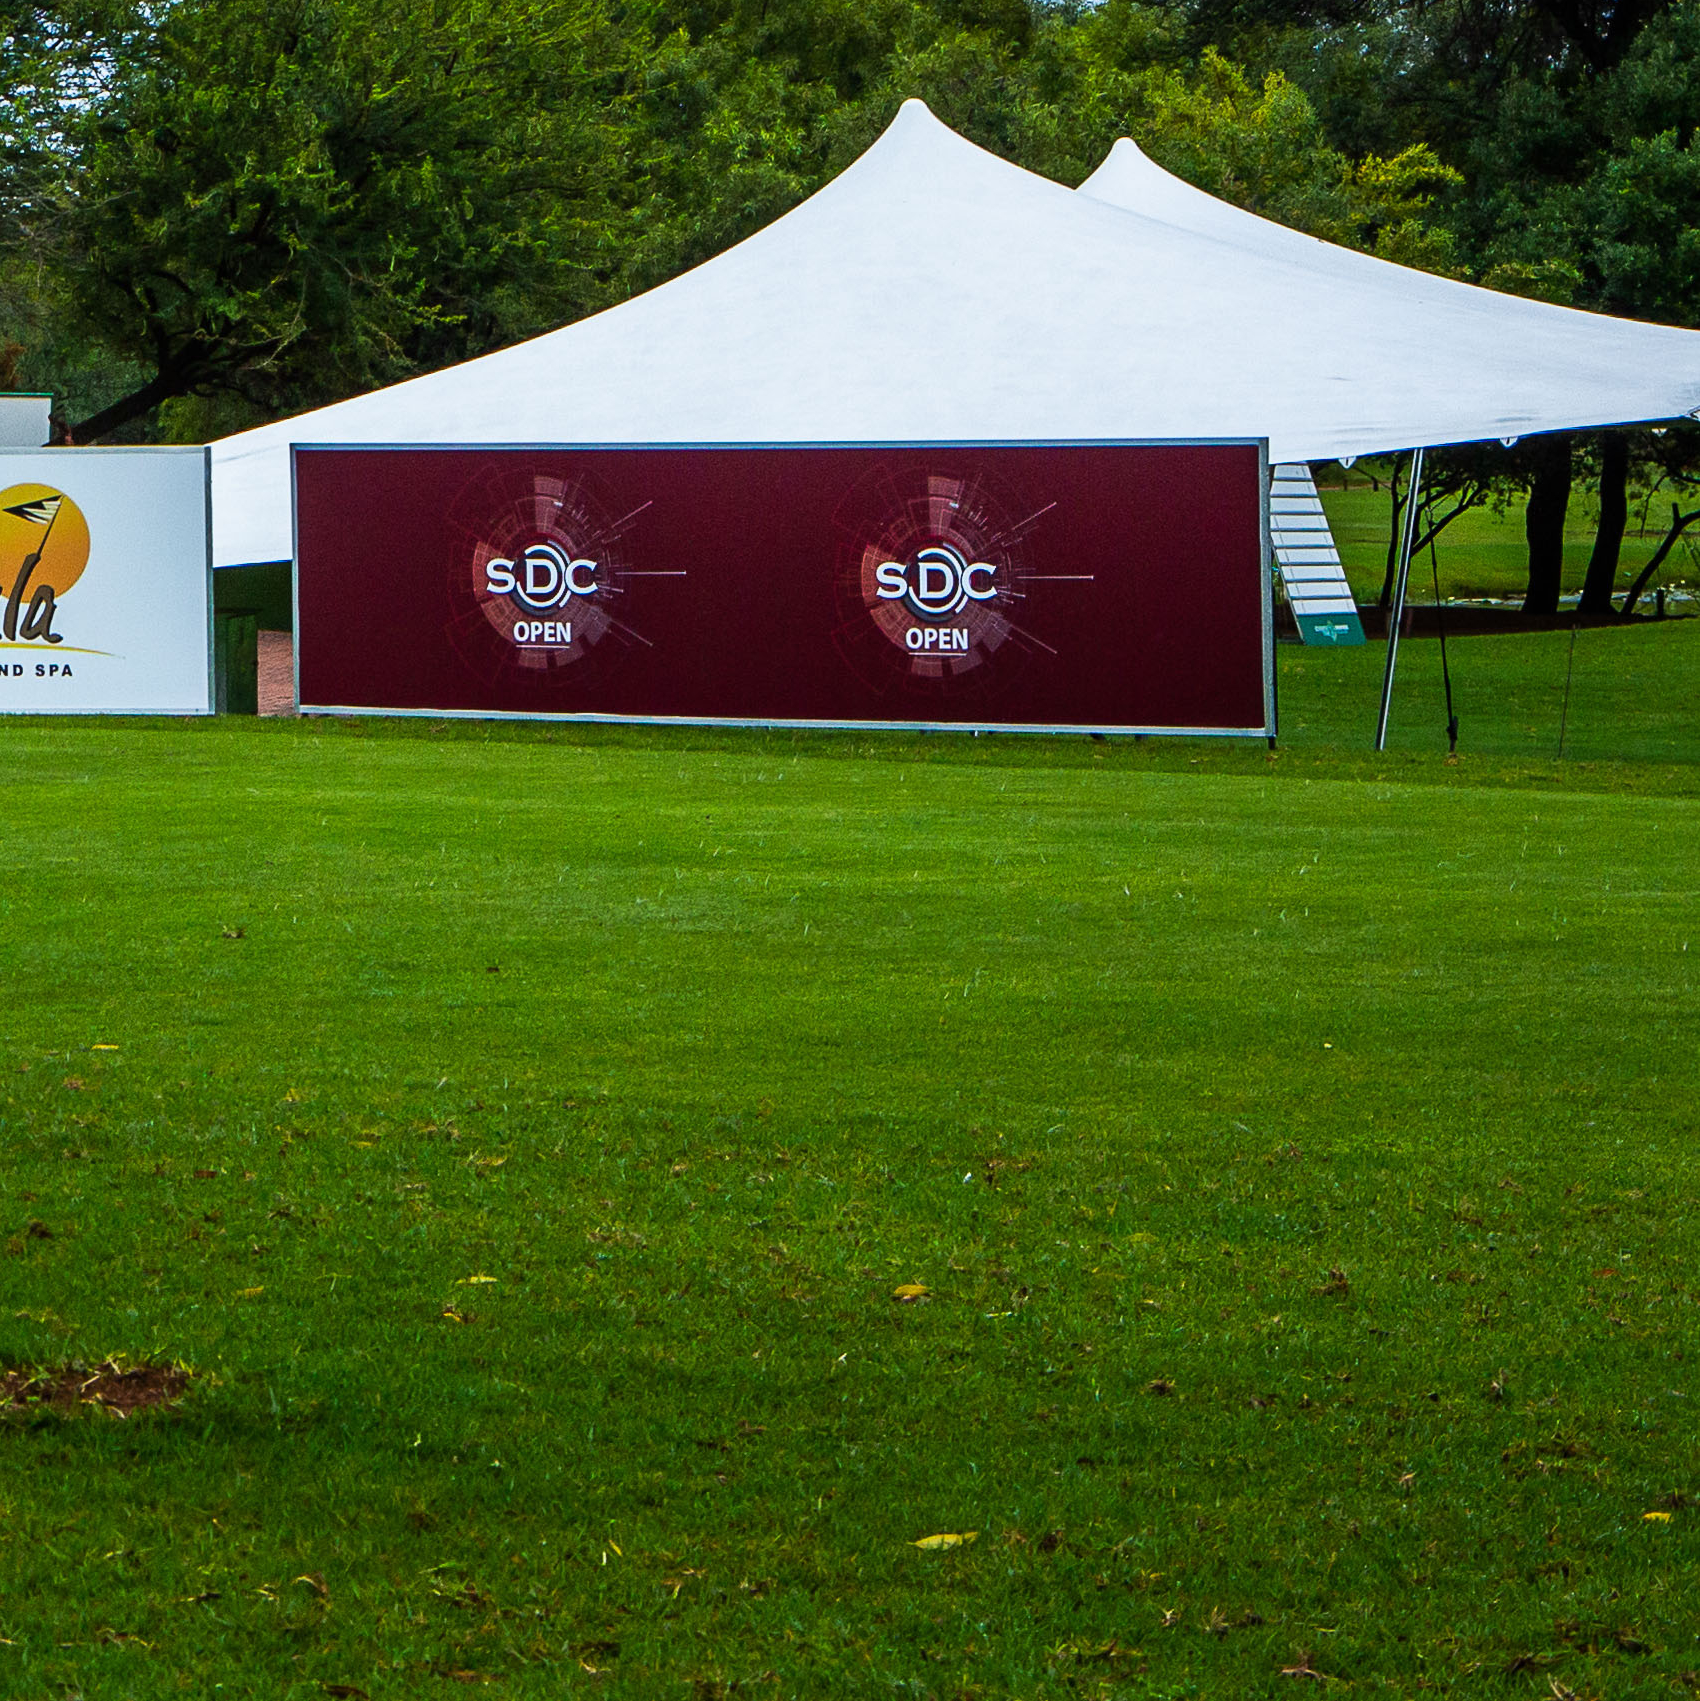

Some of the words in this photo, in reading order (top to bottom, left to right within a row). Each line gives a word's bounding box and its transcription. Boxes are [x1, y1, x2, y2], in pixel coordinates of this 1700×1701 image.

[486, 557, 598, 595] SDC
[875, 561, 998, 600] SDC
[513, 620, 572, 643] OPEN
[905, 627, 969, 650] OPEN
[35, 664, 74, 677] SPA
